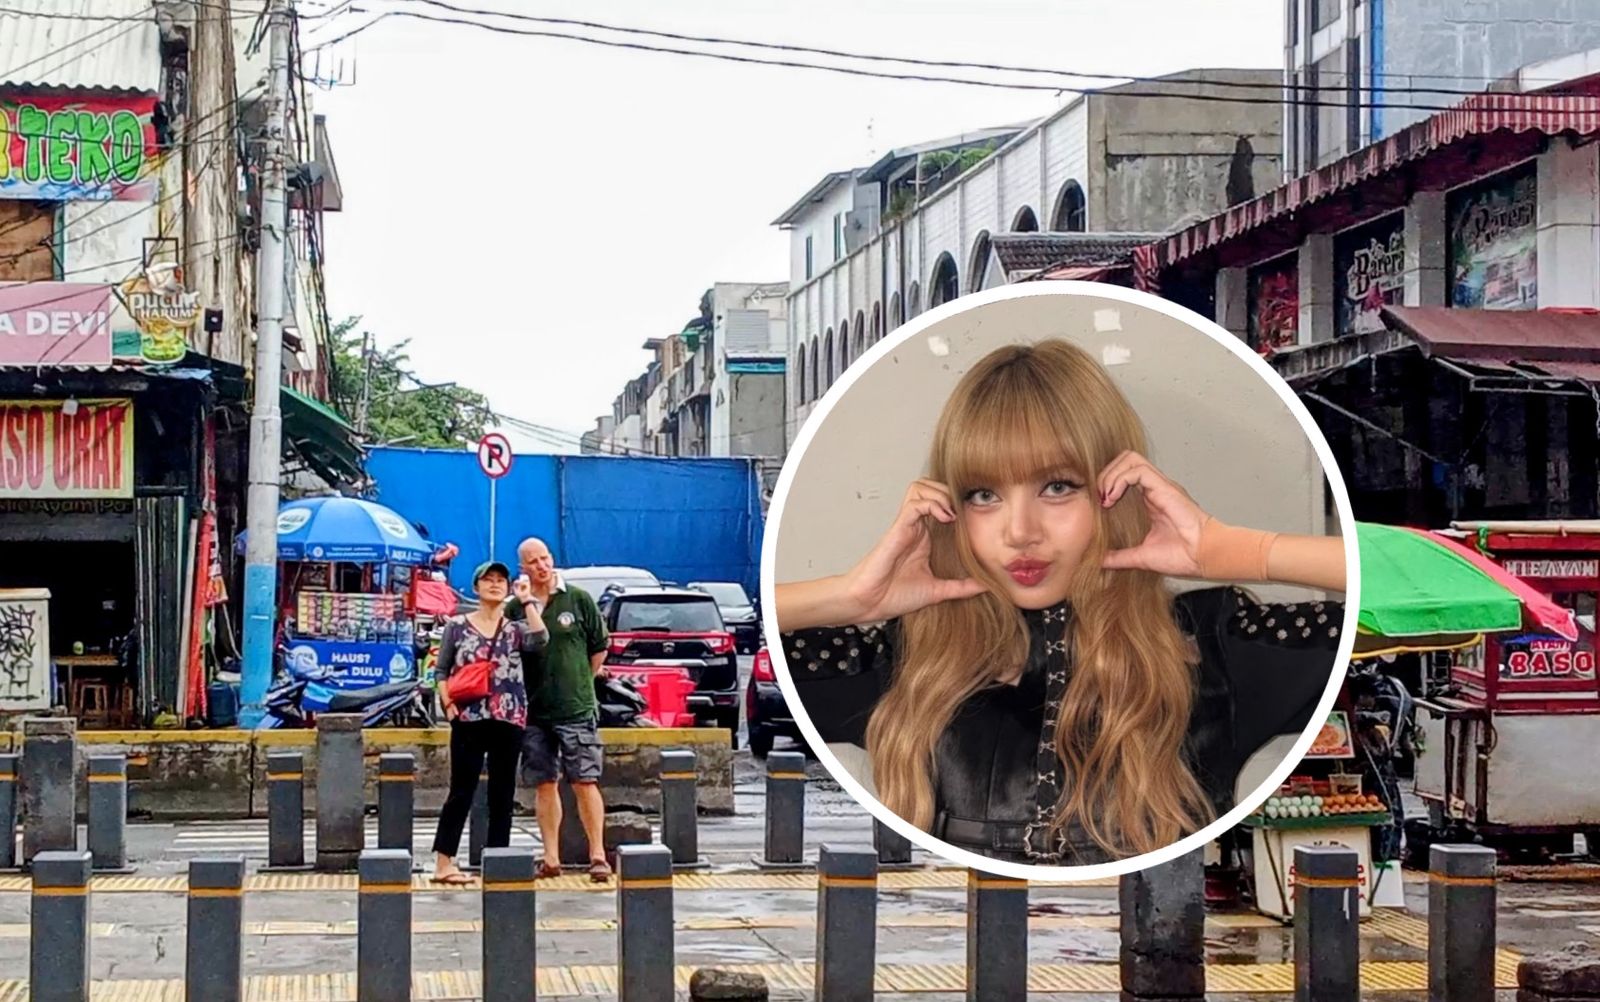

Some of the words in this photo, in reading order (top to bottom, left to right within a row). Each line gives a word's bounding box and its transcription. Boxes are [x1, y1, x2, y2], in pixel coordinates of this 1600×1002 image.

[18, 104, 144, 185] TEKO
[26, 310, 106, 336] DEVI
[0, 405, 44, 490] SO
[53, 405, 125, 490] URAT
[331, 653, 371, 664] HAUS?
[1509, 652, 1595, 676] BASO
[352, 667, 383, 678] DULU
